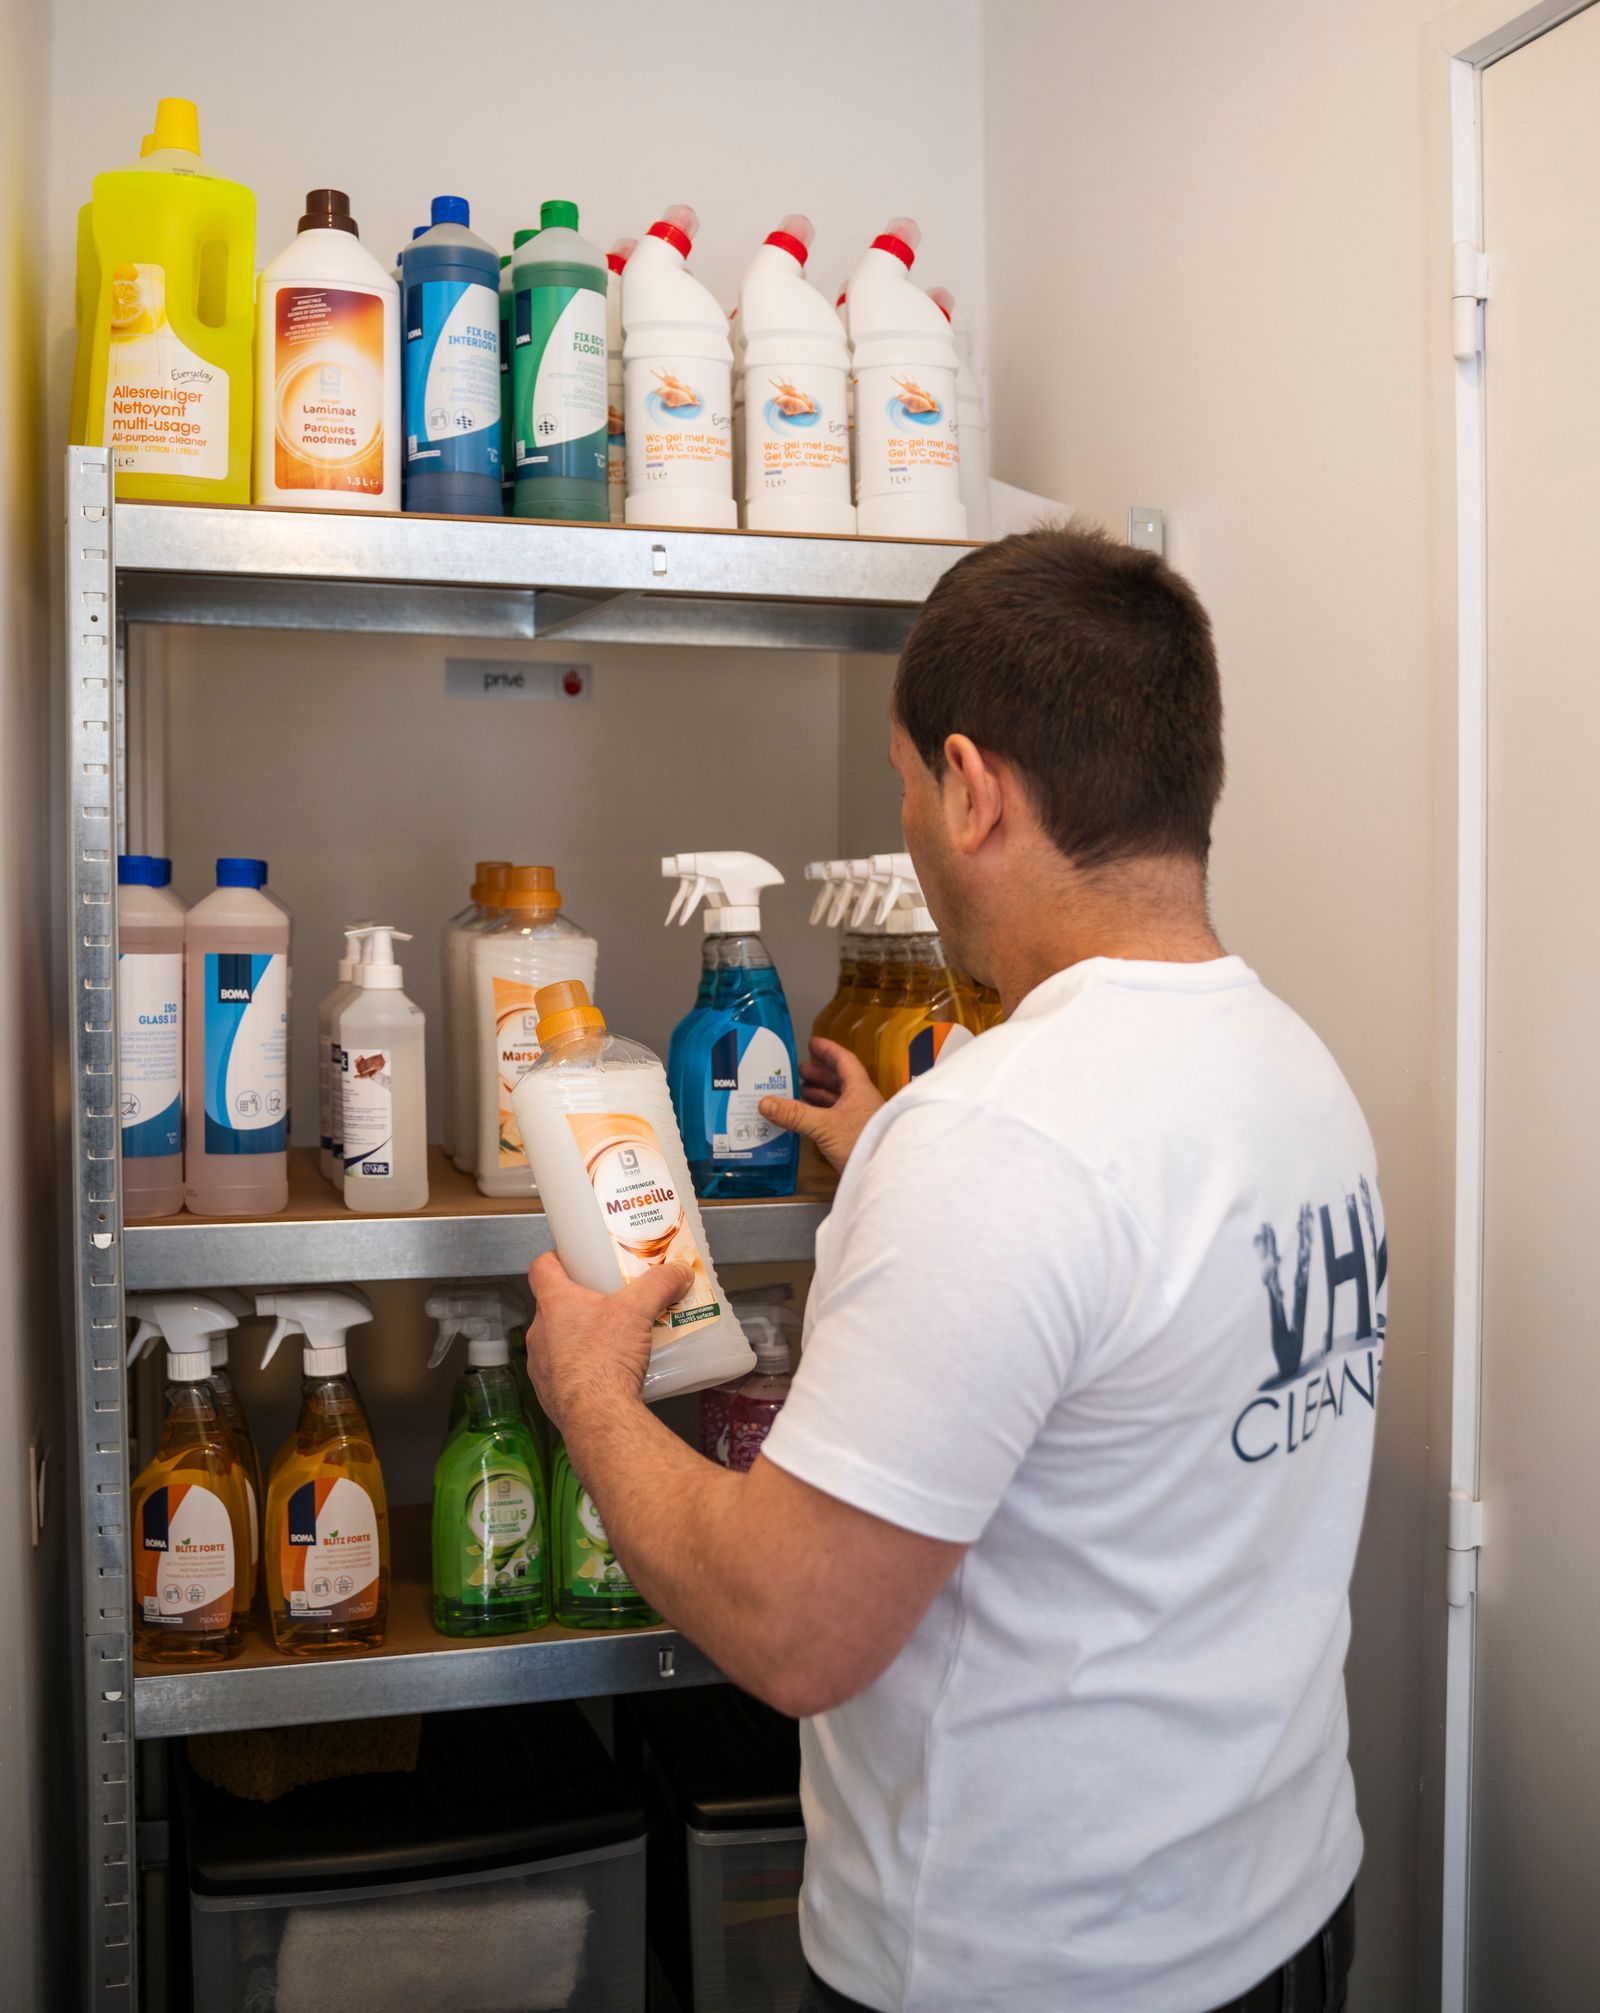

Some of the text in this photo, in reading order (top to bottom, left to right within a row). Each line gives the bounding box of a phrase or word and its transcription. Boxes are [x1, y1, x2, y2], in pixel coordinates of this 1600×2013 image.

[466, 326, 482, 337] FIX
[574, 331, 591, 343] FIX
[447, 335, 494, 350] INTERIOR
[573, 342, 601, 356] FLOOR
[170, 369, 213, 384] Everyday
[112, 385, 204, 404] Allesreiniger
[113, 401, 187, 417] Nettoyant
[303, 404, 357, 416] Laminaat
[112, 417, 201, 436] multi-usage
[303, 423, 356, 436] Parquets
[111, 433, 208, 447] All-purpose cleaner
[302, 434, 358, 446] modernes
[646, 433, 682, 445] Wc-gel
[684, 434, 705, 442] met
[887, 438, 925, 449] Wc-gel
[926, 440, 945, 448] met
[144, 445, 171, 454] CITRON
[175, 448, 200, 456] LEMON
[646, 443, 664, 453] Gel
[666, 443, 684, 451] WC
[686, 445, 712, 454] avec
[763, 441, 800, 451] Wc-gel
[802, 442, 822, 450] met
[763, 451, 782, 461] Gel
[784, 450, 802, 459] WC
[804, 452, 829, 461] avec
[888, 448, 907, 458] Gel
[909, 448, 928, 457] WC
[928, 450, 951, 460] avec
[220, 989, 250, 1000] BOMA
[164, 1003, 178, 1013] ISO
[138, 1014, 169, 1025] GLASS
[502, 1050, 540, 1061] Marse
[713, 1079, 737, 1088] BOMA
[768, 1075, 787, 1084] BLITZ
[753, 1083, 788, 1091] INTERIOR
[615, 1179, 656, 1194] ALLESREINIGER
[605, 1187, 675, 1215] Marseille
[629, 1208, 660, 1221] NETTOYANT
[629, 1214, 664, 1227] MULTI-USAGE
[685, 1305, 714, 1317] oppervlakken
[678, 1311, 715, 1325] TOUTES surfaces
[1231, 1350, 1383, 1463] CLEAN
[479, 1507, 528, 1523] Citrus
[144, 1537, 167, 1549] BOMA
[291, 1533, 315, 1543] BOMA
[323, 1533, 371, 1546] BLITZ FORTE
[175, 1543, 225, 1553] BLITZ FORTE
